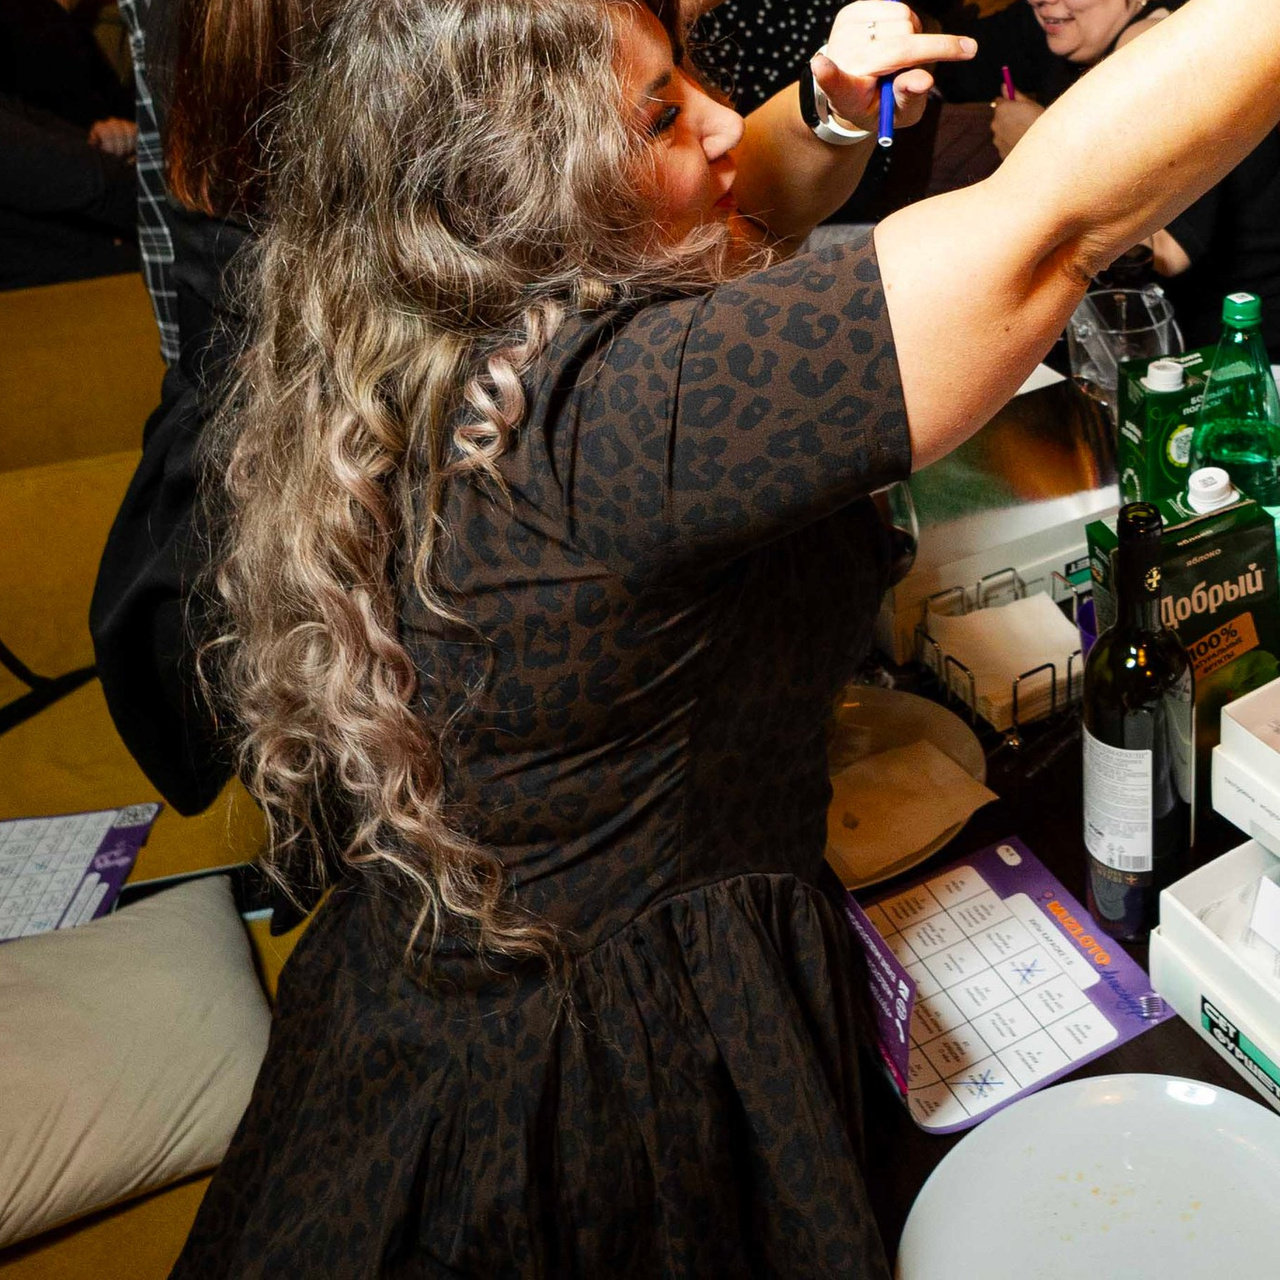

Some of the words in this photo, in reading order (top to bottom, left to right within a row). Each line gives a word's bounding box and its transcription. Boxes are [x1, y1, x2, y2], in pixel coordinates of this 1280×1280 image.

[1160, 563, 1265, 631] Добрый
[1046, 900, 1112, 967] MUZLOTO
[1203, 1002, 1237, 1039] СЕТ
